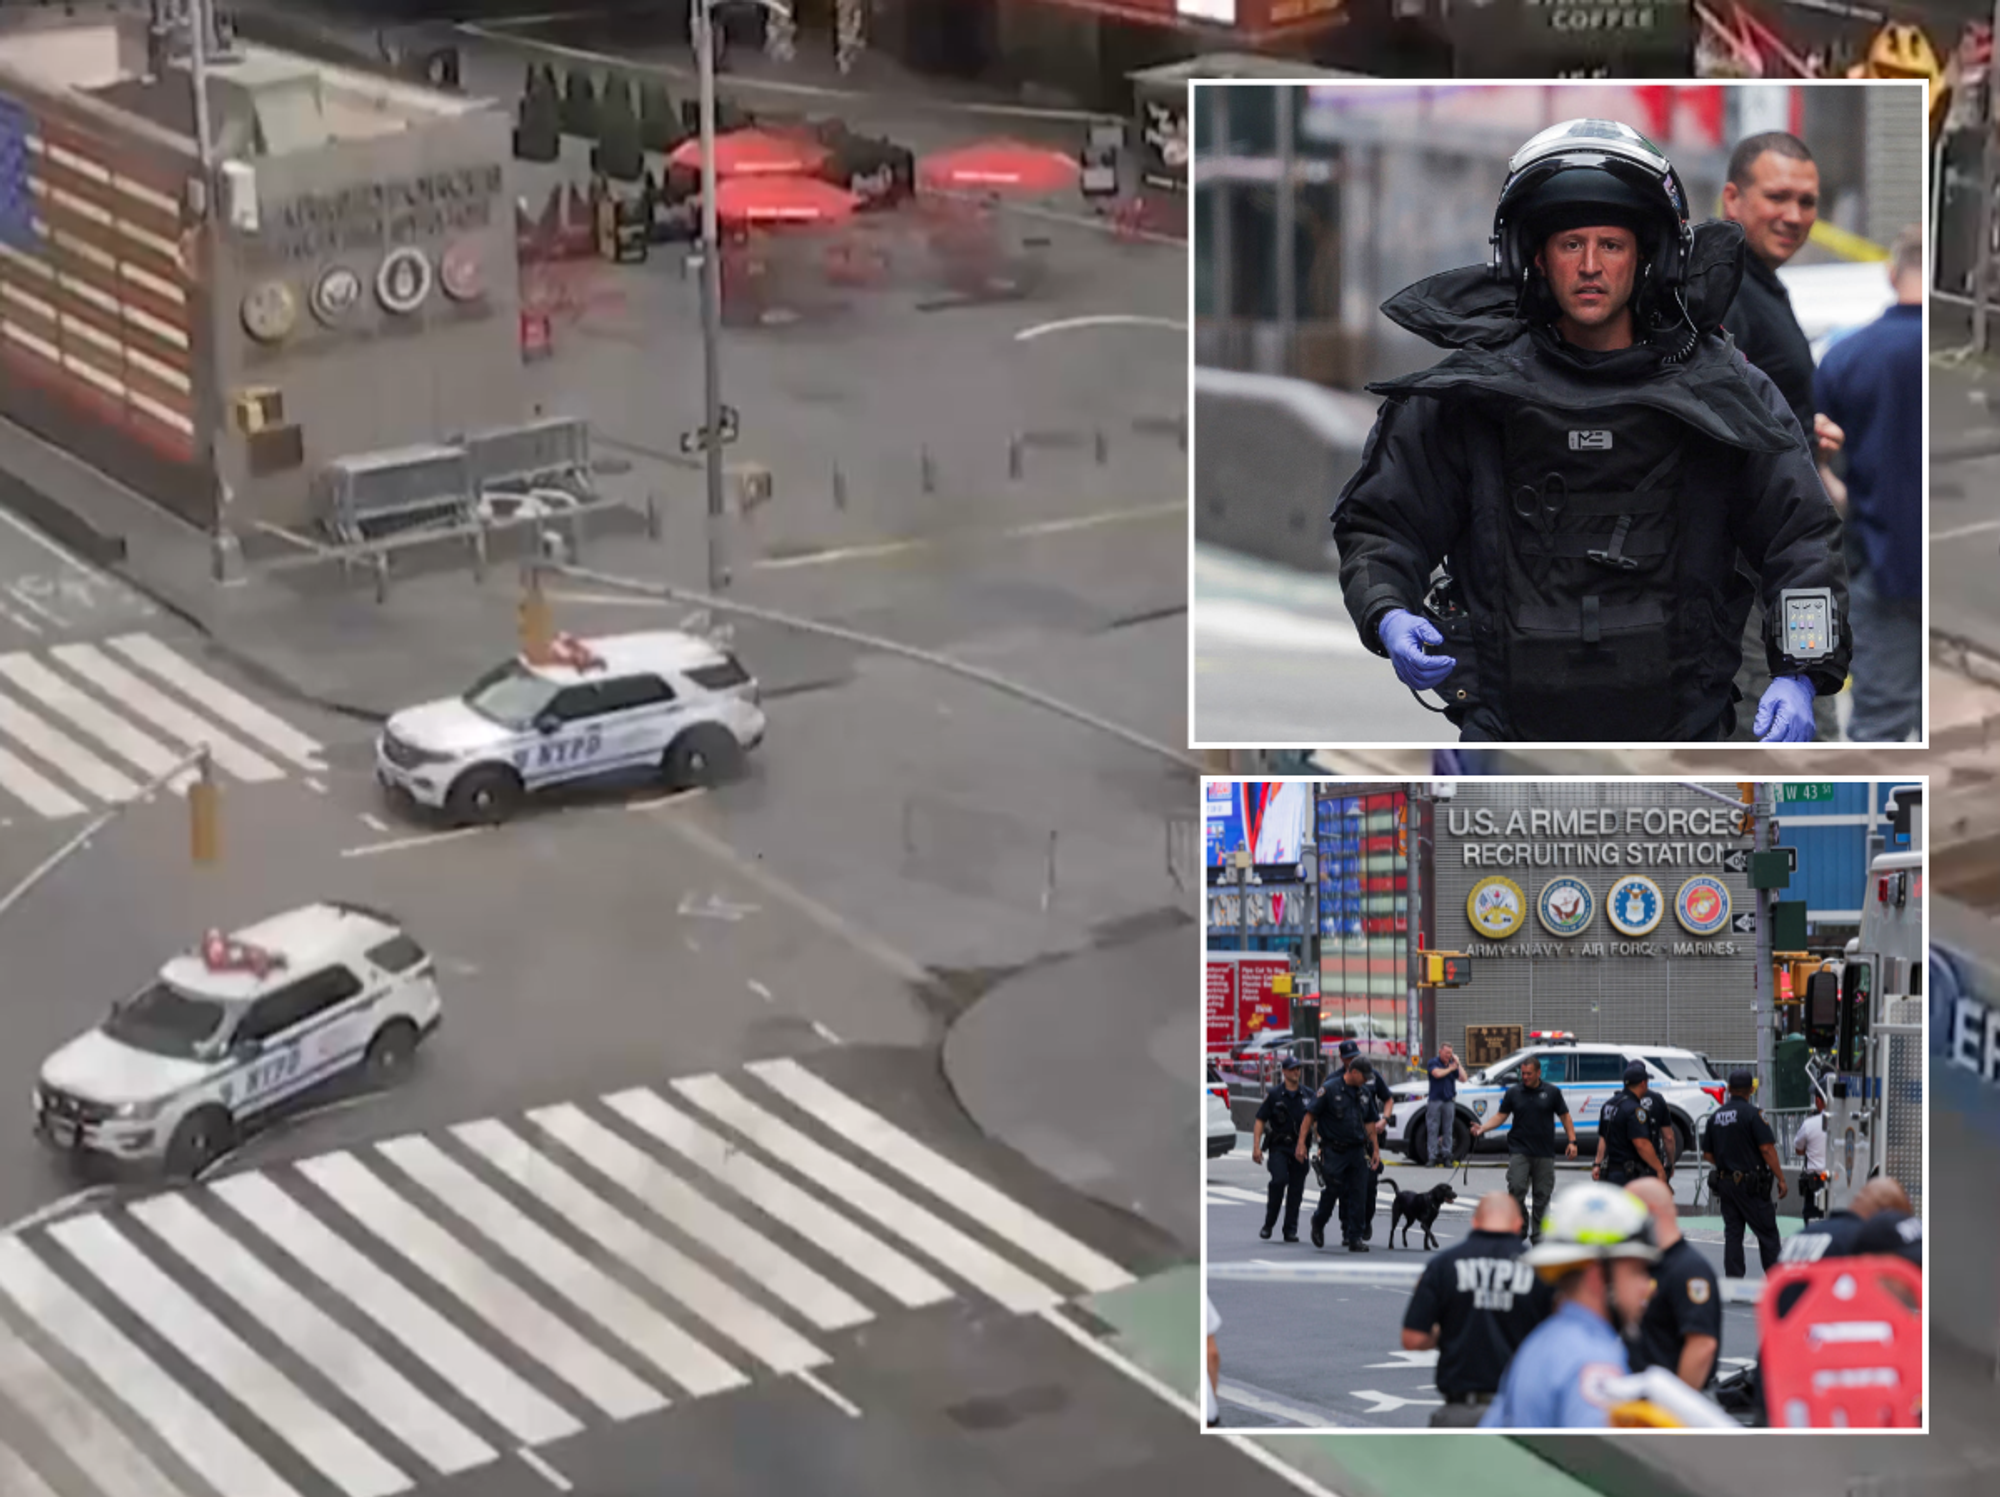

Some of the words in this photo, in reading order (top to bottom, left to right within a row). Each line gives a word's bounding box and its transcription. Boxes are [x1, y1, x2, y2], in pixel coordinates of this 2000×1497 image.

[1786, 785, 1797, 799] W
[1803, 784, 1818, 799] 43
[1448, 808, 1500, 835] U.S.
[1505, 807, 1620, 835] ARMED
[1626, 807, 1744, 835] FORCES
[1463, 843, 1620, 866] RECRUITING
[1466, 943, 1508, 957] ARMY
[1520, 943, 1564, 956] NAVY
[1581, 942, 1605, 956] AIR
[1673, 942, 1734, 956] MARINES
[1455, 1257, 1534, 1294] NYPD
